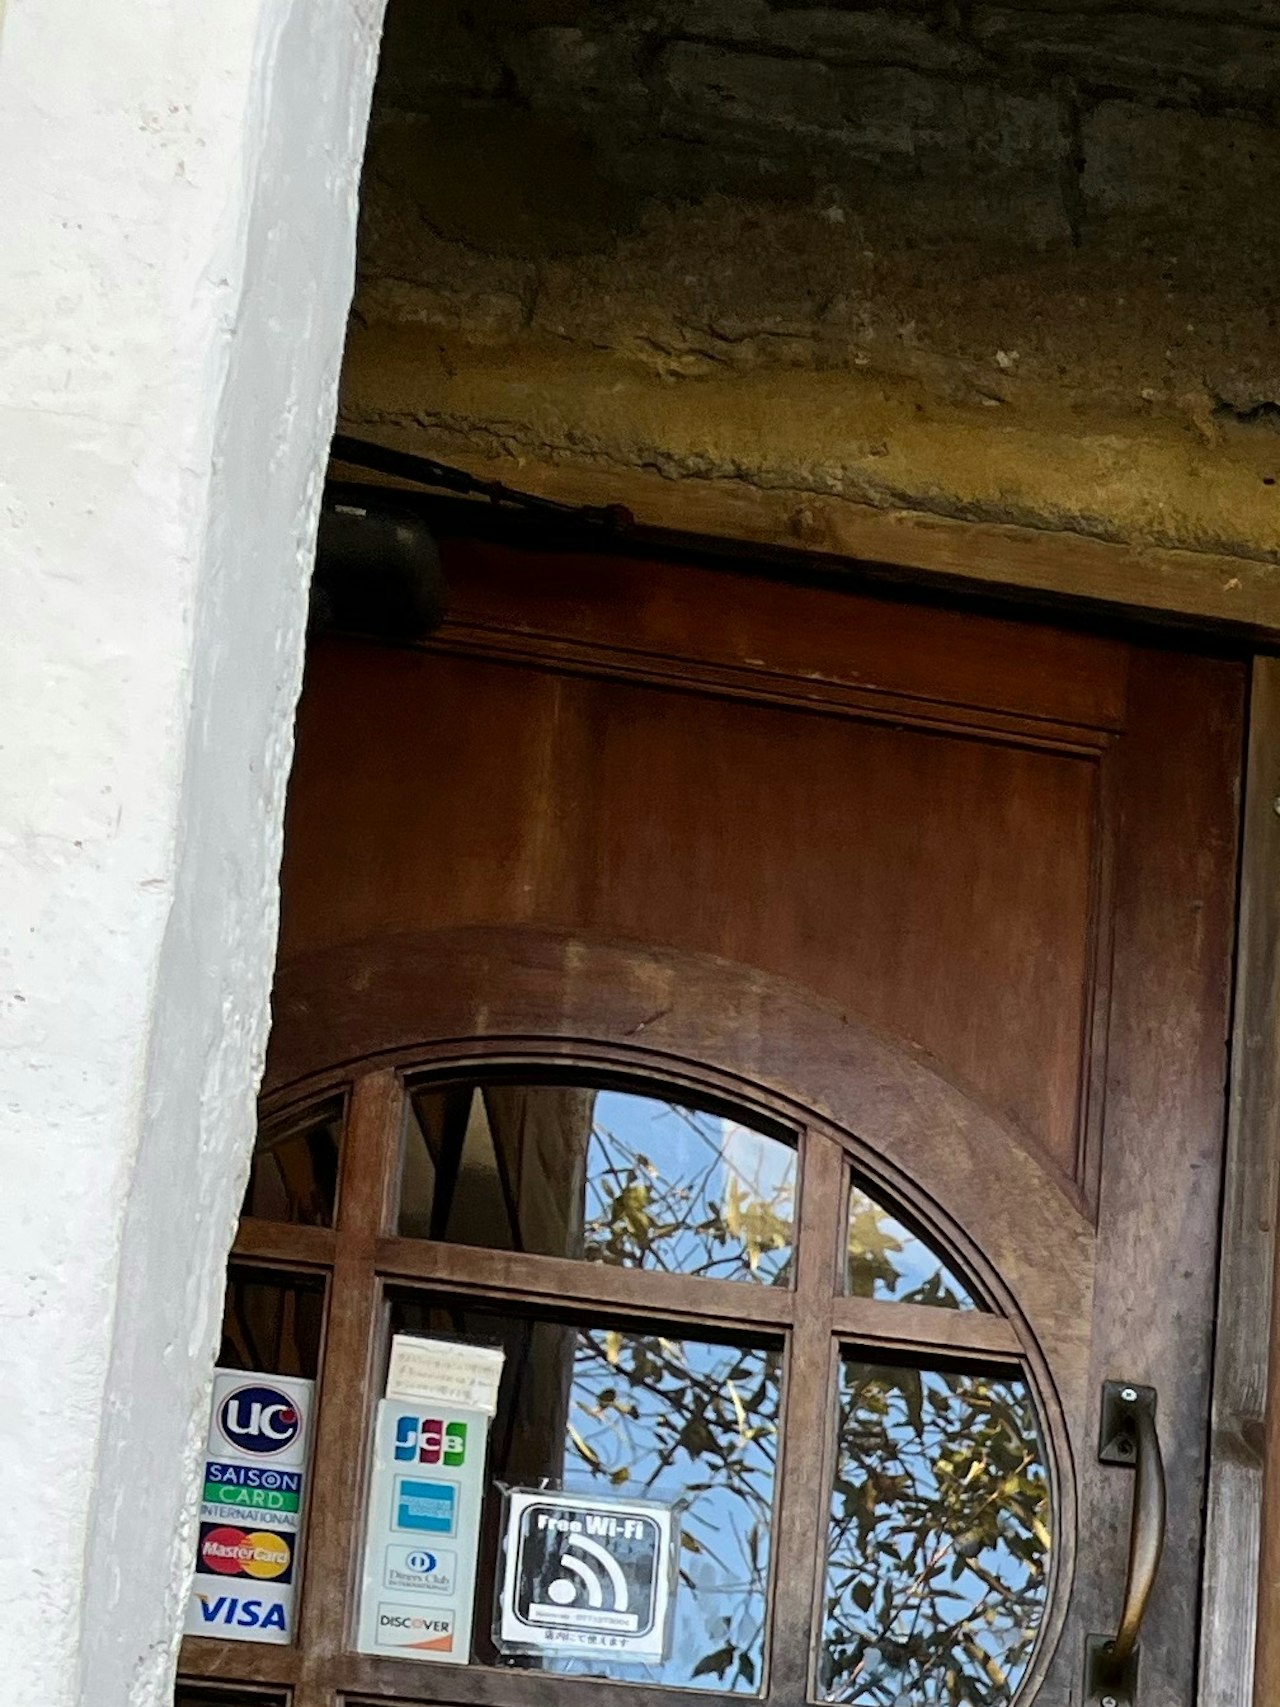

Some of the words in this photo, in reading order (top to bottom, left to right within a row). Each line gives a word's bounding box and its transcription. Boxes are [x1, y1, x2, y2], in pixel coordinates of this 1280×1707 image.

[208, 1464, 299, 1491] SAISON
[219, 1486, 285, 1508] CARD
[201, 1504, 297, 1526] INTERNATIONAL
[537, 1514, 583, 1533] Free
[202, 1541, 289, 1563] MasterCard
[197, 1596, 287, 1631] VISA
[380, 1614, 450, 1633] DISCOVER
